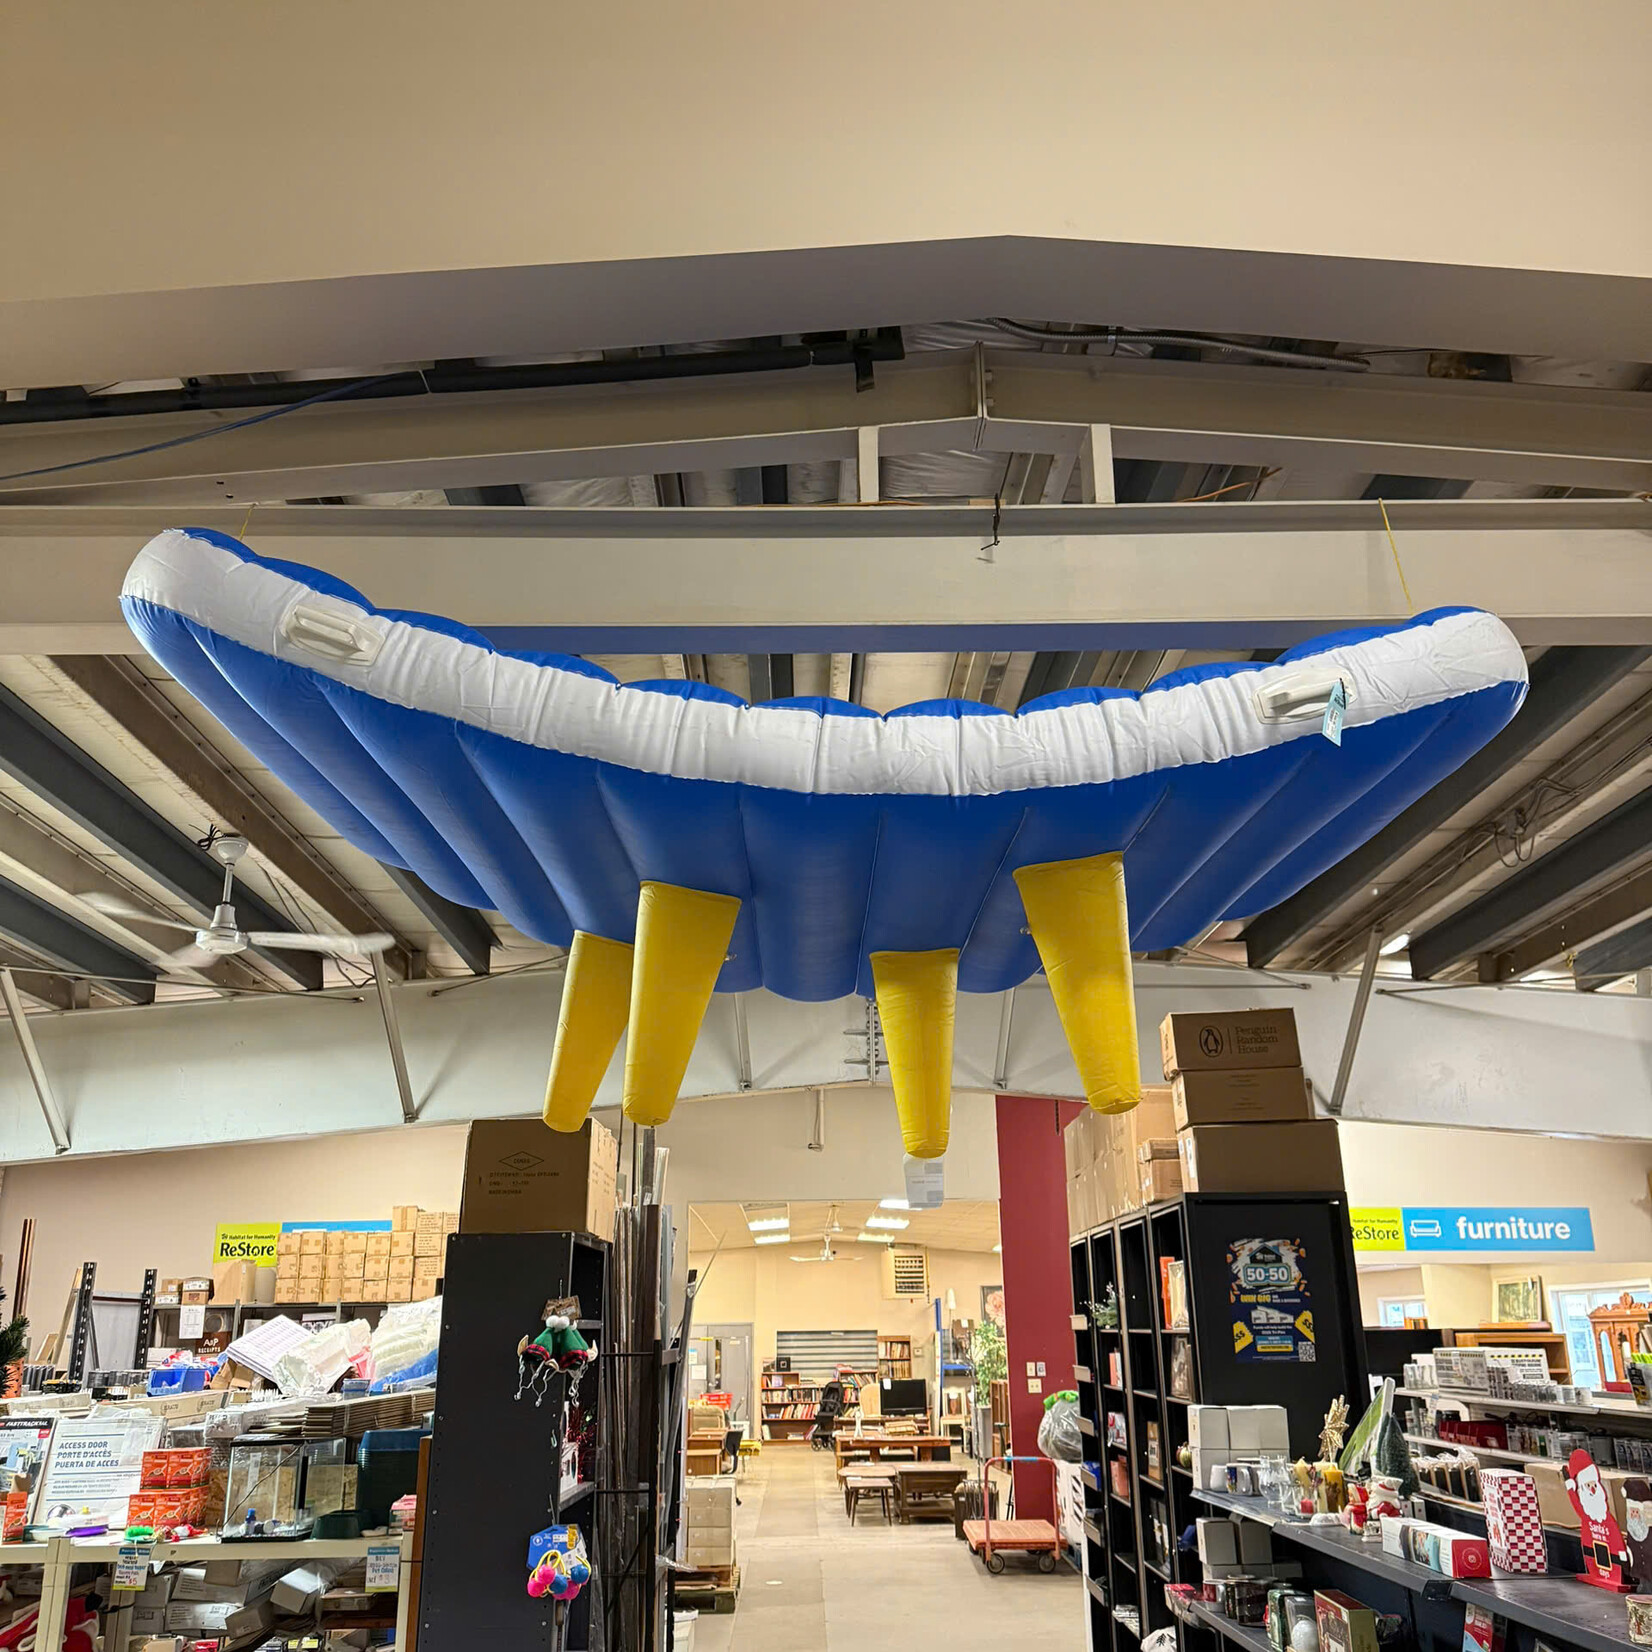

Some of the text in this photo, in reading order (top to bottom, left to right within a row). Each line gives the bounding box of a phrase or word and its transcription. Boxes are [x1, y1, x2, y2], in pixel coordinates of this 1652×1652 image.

[1235, 1026, 1277, 1036] Penguin
[1236, 1035, 1278, 1044] Random
[1238, 1045, 1269, 1054] House
[1456, 1216, 1570, 1240] furniture
[220, 1242, 275, 1257] ReStore
[1246, 1267, 1288, 1281] 50-50
[88, 1441, 108, 1449] DOOR
[83, 1449, 112, 1458] D'ACCÈS
[1588, 1521, 1610, 1537] Santa's
